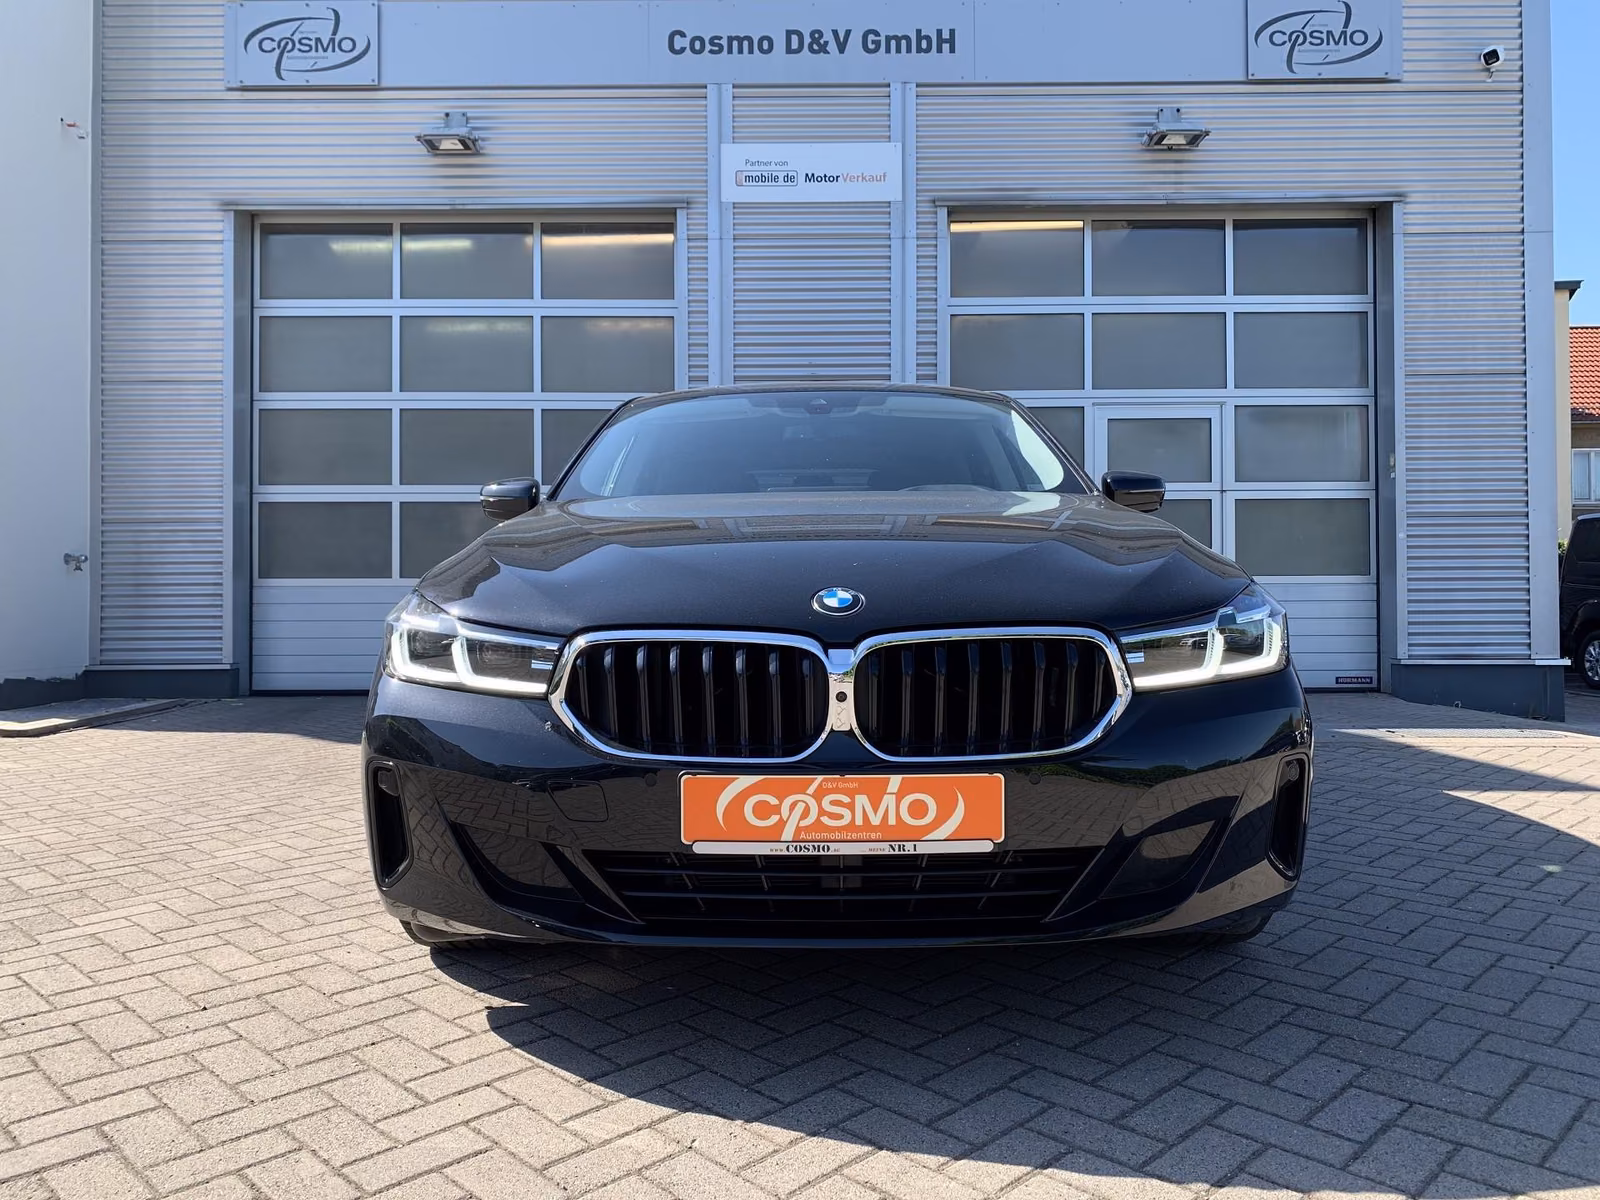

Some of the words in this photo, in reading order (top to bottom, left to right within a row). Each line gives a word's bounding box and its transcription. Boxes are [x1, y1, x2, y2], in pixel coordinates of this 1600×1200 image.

[258, 36, 357, 54] COSMO
[667, 29, 774, 56] Cosmo
[785, 28, 852, 55] D&V
[861, 28, 956, 55] GmbH
[1268, 29, 1369, 47] COSMO
[745, 158, 773, 168] Partner
[773, 160, 789, 168] von
[822, 781, 837, 789] D&V
[838, 781, 859, 789] GmbH
[743, 792, 937, 827] COSMO
[799, 830, 882, 840] Automobilzentren
